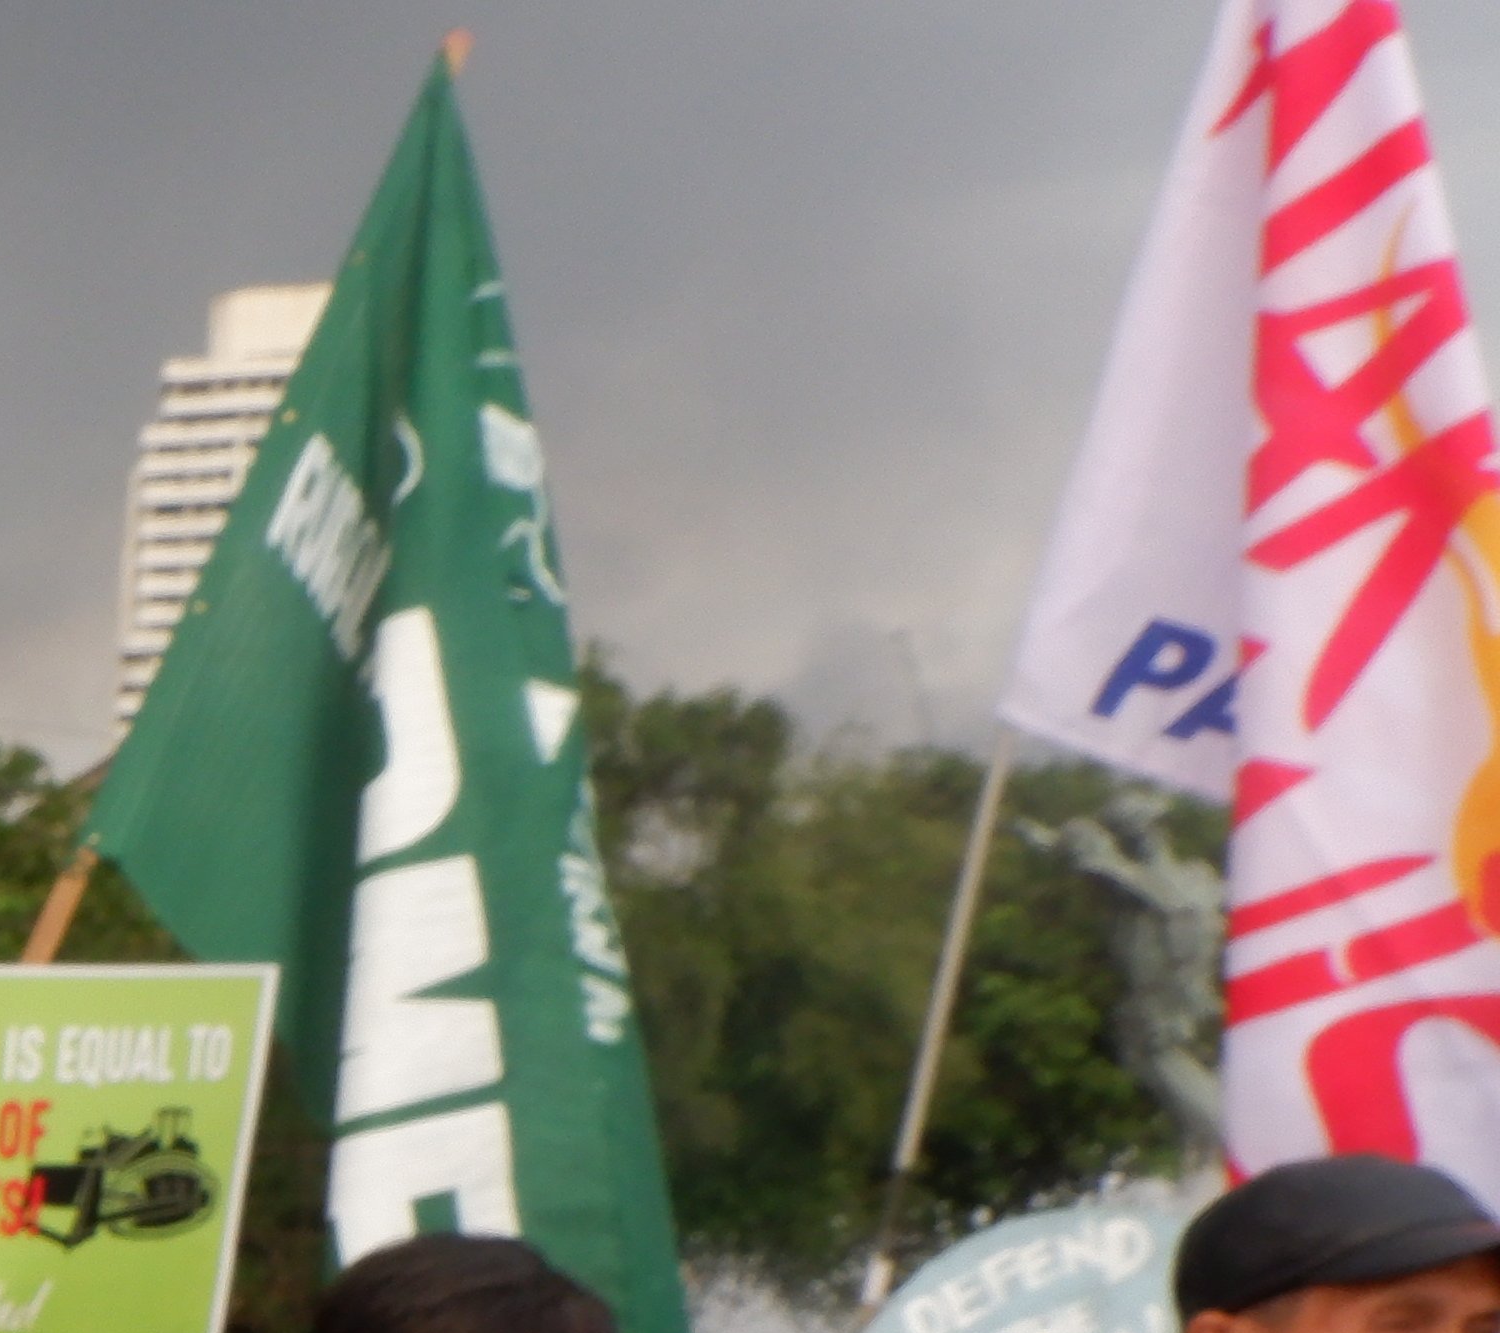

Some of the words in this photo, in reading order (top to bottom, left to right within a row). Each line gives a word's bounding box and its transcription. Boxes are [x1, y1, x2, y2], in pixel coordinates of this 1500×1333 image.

[2, 1024, 45, 1082] IS
[55, 1024, 175, 1087] EQUAL
[188, 1025, 232, 1082] TO
